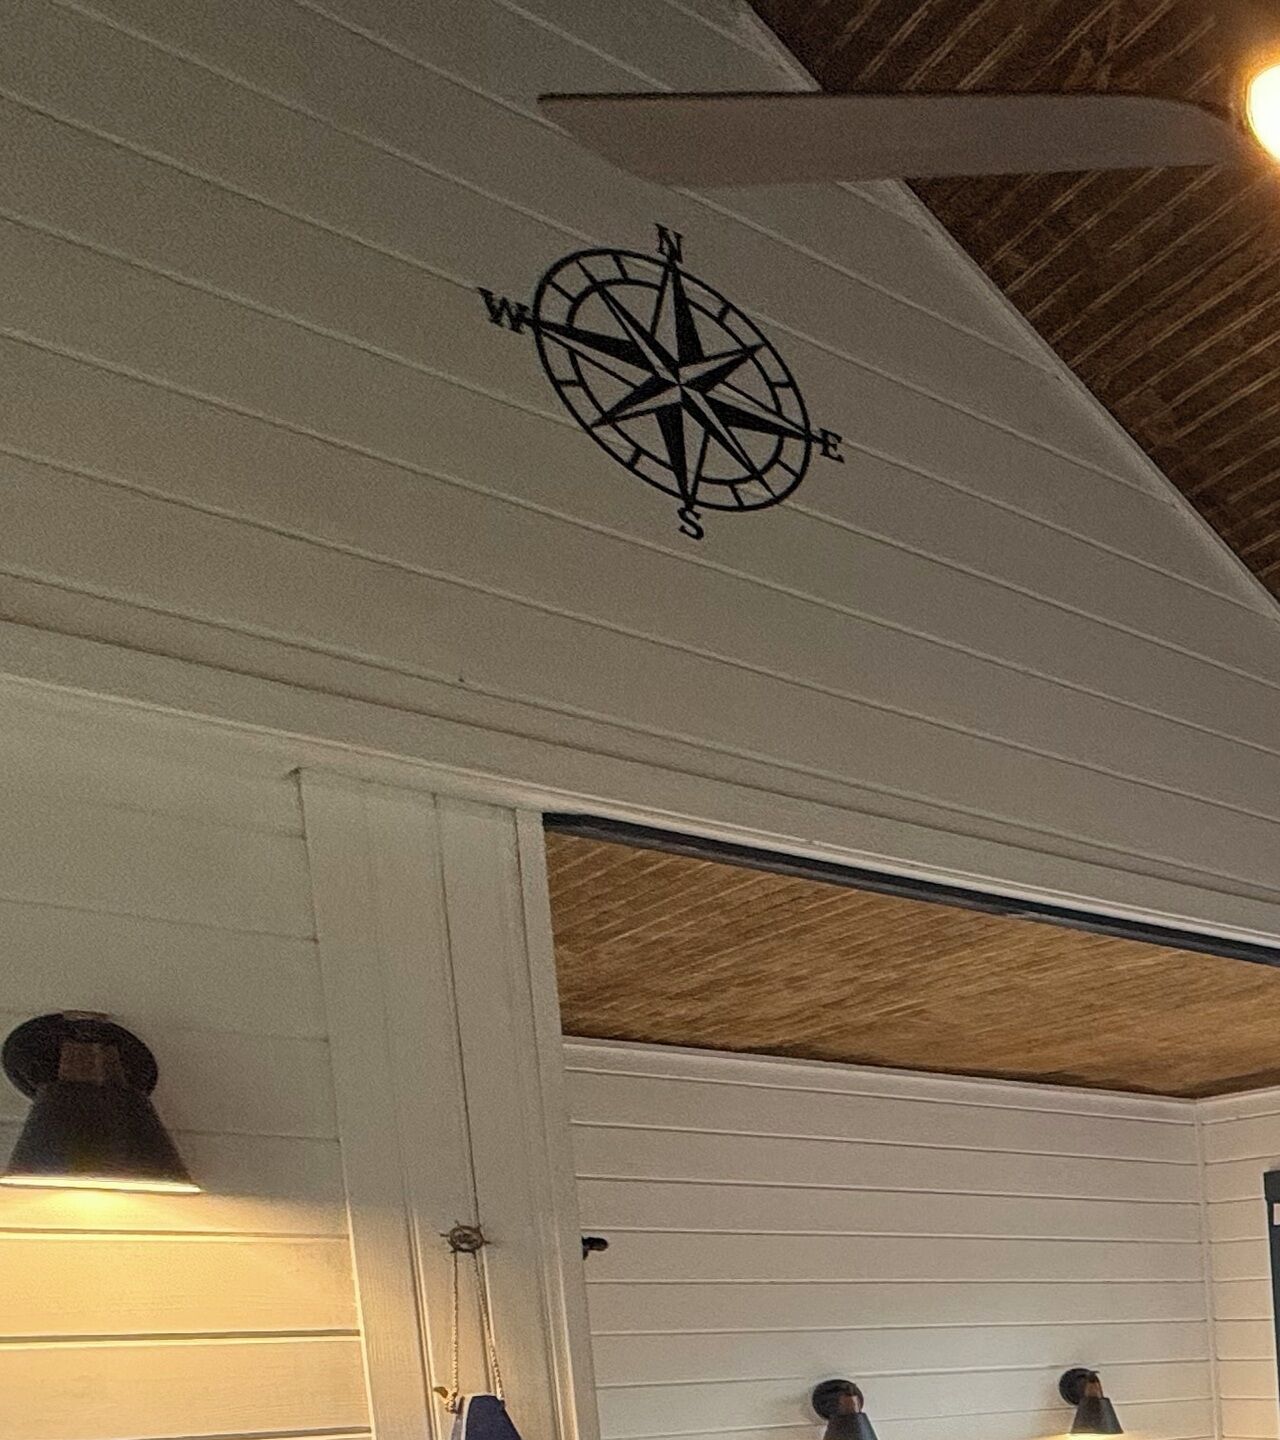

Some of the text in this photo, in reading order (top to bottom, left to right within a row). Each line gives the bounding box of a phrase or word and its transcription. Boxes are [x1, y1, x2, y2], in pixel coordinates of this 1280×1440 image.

[655, 223, 683, 263] N
[477, 286, 526, 334] W
[819, 428, 844, 463] E
[677, 505, 704, 540] S
